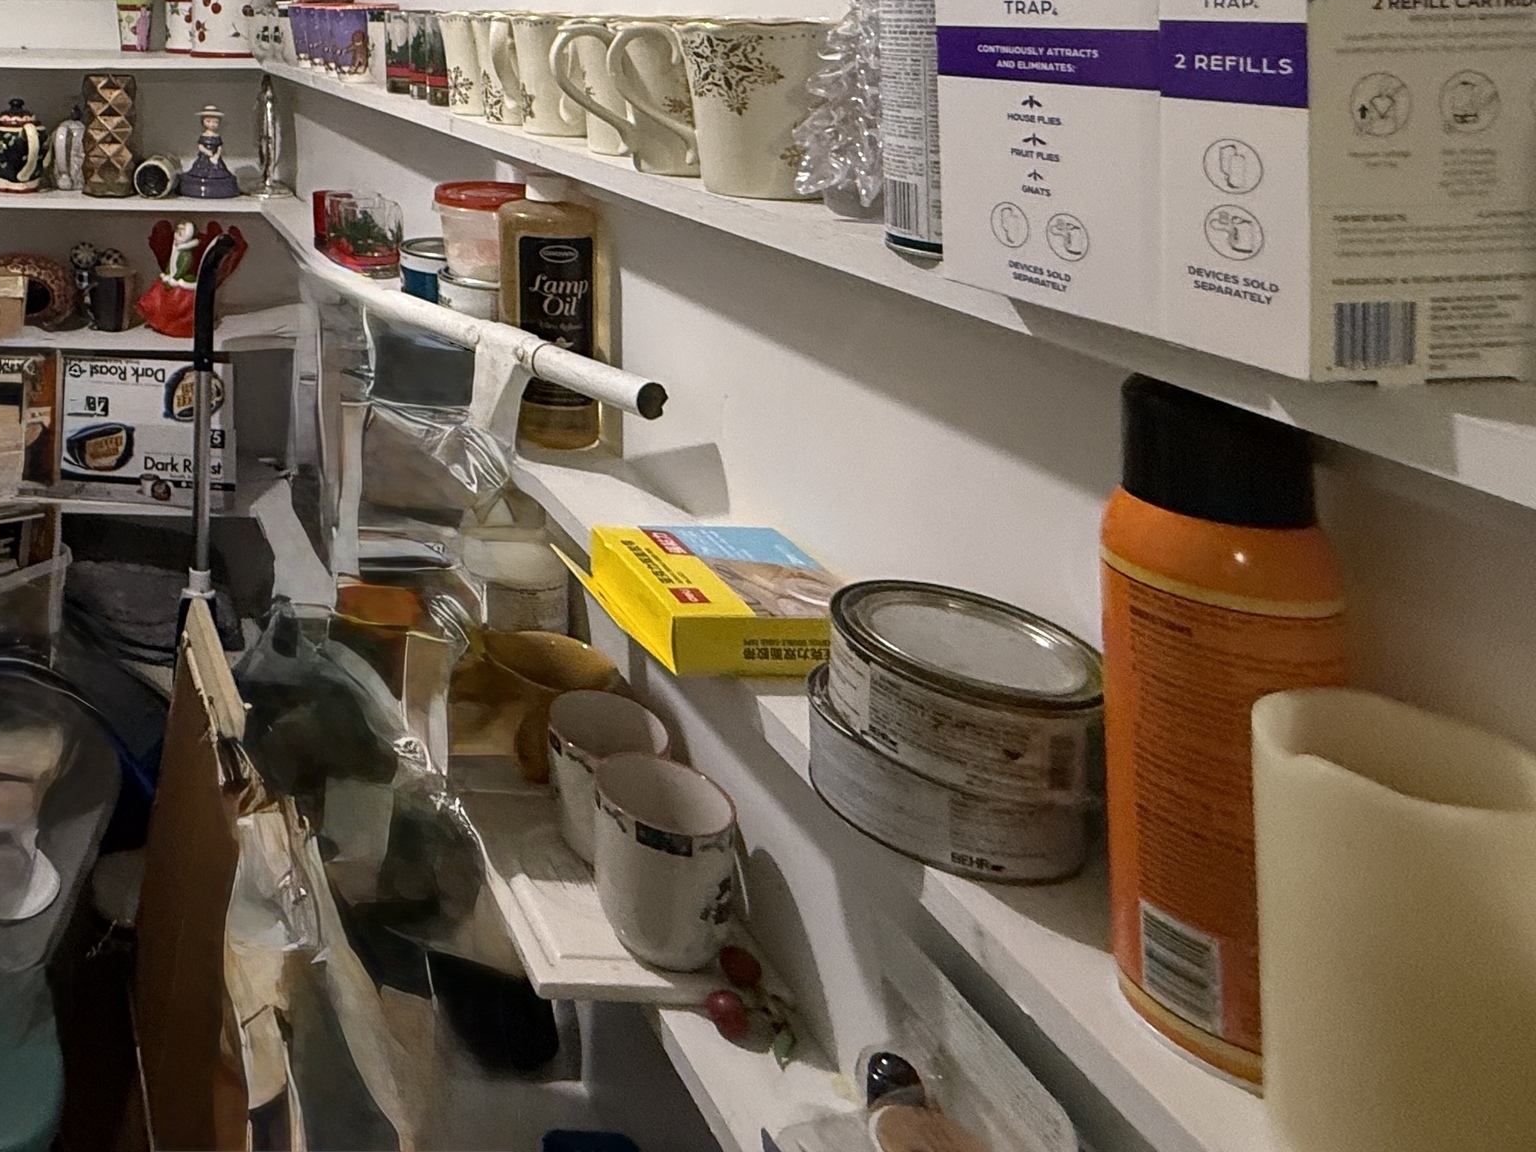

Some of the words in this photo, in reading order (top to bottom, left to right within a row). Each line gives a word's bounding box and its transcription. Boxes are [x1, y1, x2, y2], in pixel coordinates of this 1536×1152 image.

[977, 44, 1044, 57] CONTINUOUSLY
[1046, 46, 1099, 59] ATTRACTS
[996, 60, 1016, 69] AND
[1173, 53, 1187, 70] 2
[1195, 55, 1294, 74] REFILLS
[1007, 112, 1036, 124] HOUSE
[1036, 114, 1062, 126] FLIES
[1010, 147, 1036, 160] FRUIT
[1036, 150, 1061, 163] FLIES
[1021, 184, 1052, 197] GNATS
[1008, 260, 1044, 277] DEVICES
[1045, 268, 1072, 283] SOLD
[1188, 265, 1240, 285] DEVICES
[1242, 275, 1280, 294] SOLD
[528, 273, 589, 299] Lamp
[1012, 272, 1068, 292] SEPARATELY
[1193, 280, 1273, 305] SEPARATELY
[543, 296, 577, 316] Oil
[90, 364, 127, 381] Roast
[132, 367, 166, 383] Dark
[144, 456, 179, 473] Dark
[183, 458, 222, 475] Rst
[950, 851, 991, 871] BEHR
